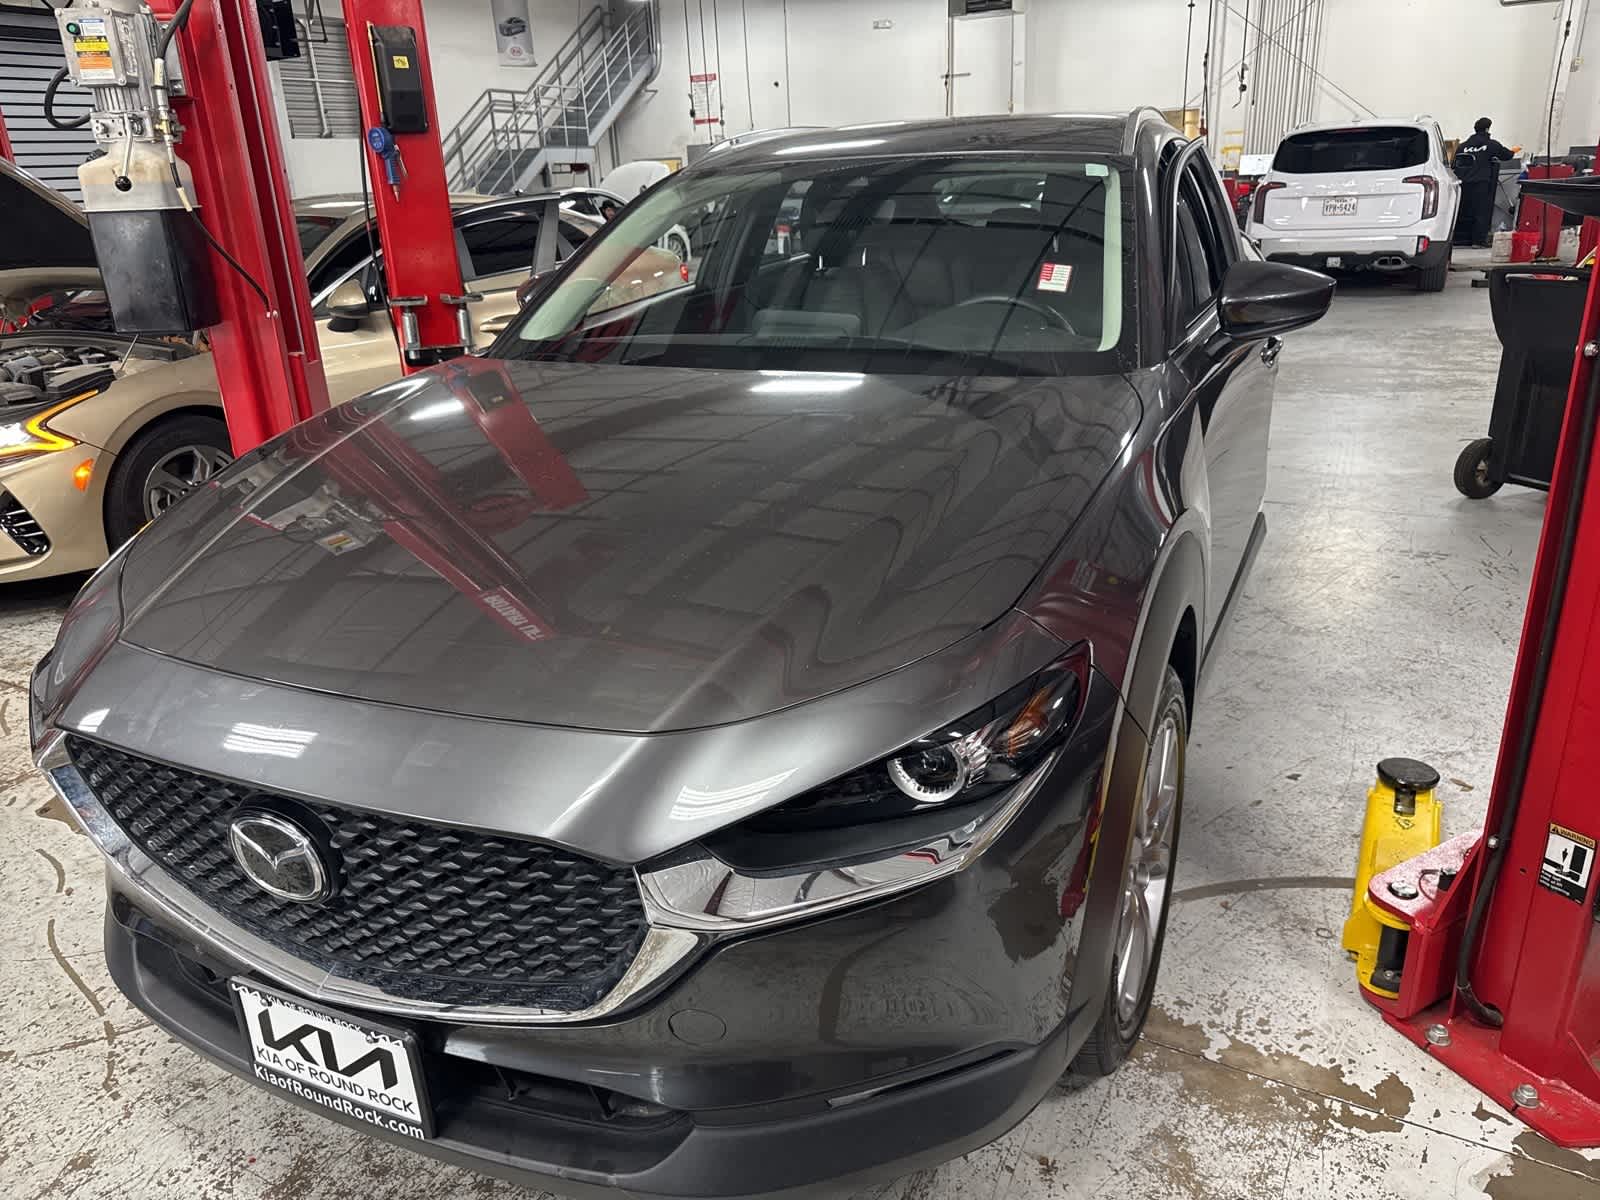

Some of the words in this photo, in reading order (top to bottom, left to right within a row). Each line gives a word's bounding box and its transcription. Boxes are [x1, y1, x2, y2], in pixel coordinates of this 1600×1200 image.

[1560, 828, 1594, 847] WARNING
[253, 1064, 425, 1140] KiaofRoundRock.com
[256, 1045, 284, 1068] KIA
[285, 1058, 305, 1074] OF
[309, 1066, 364, 1097] ROUND
[367, 1088, 416, 1115] ROCK
